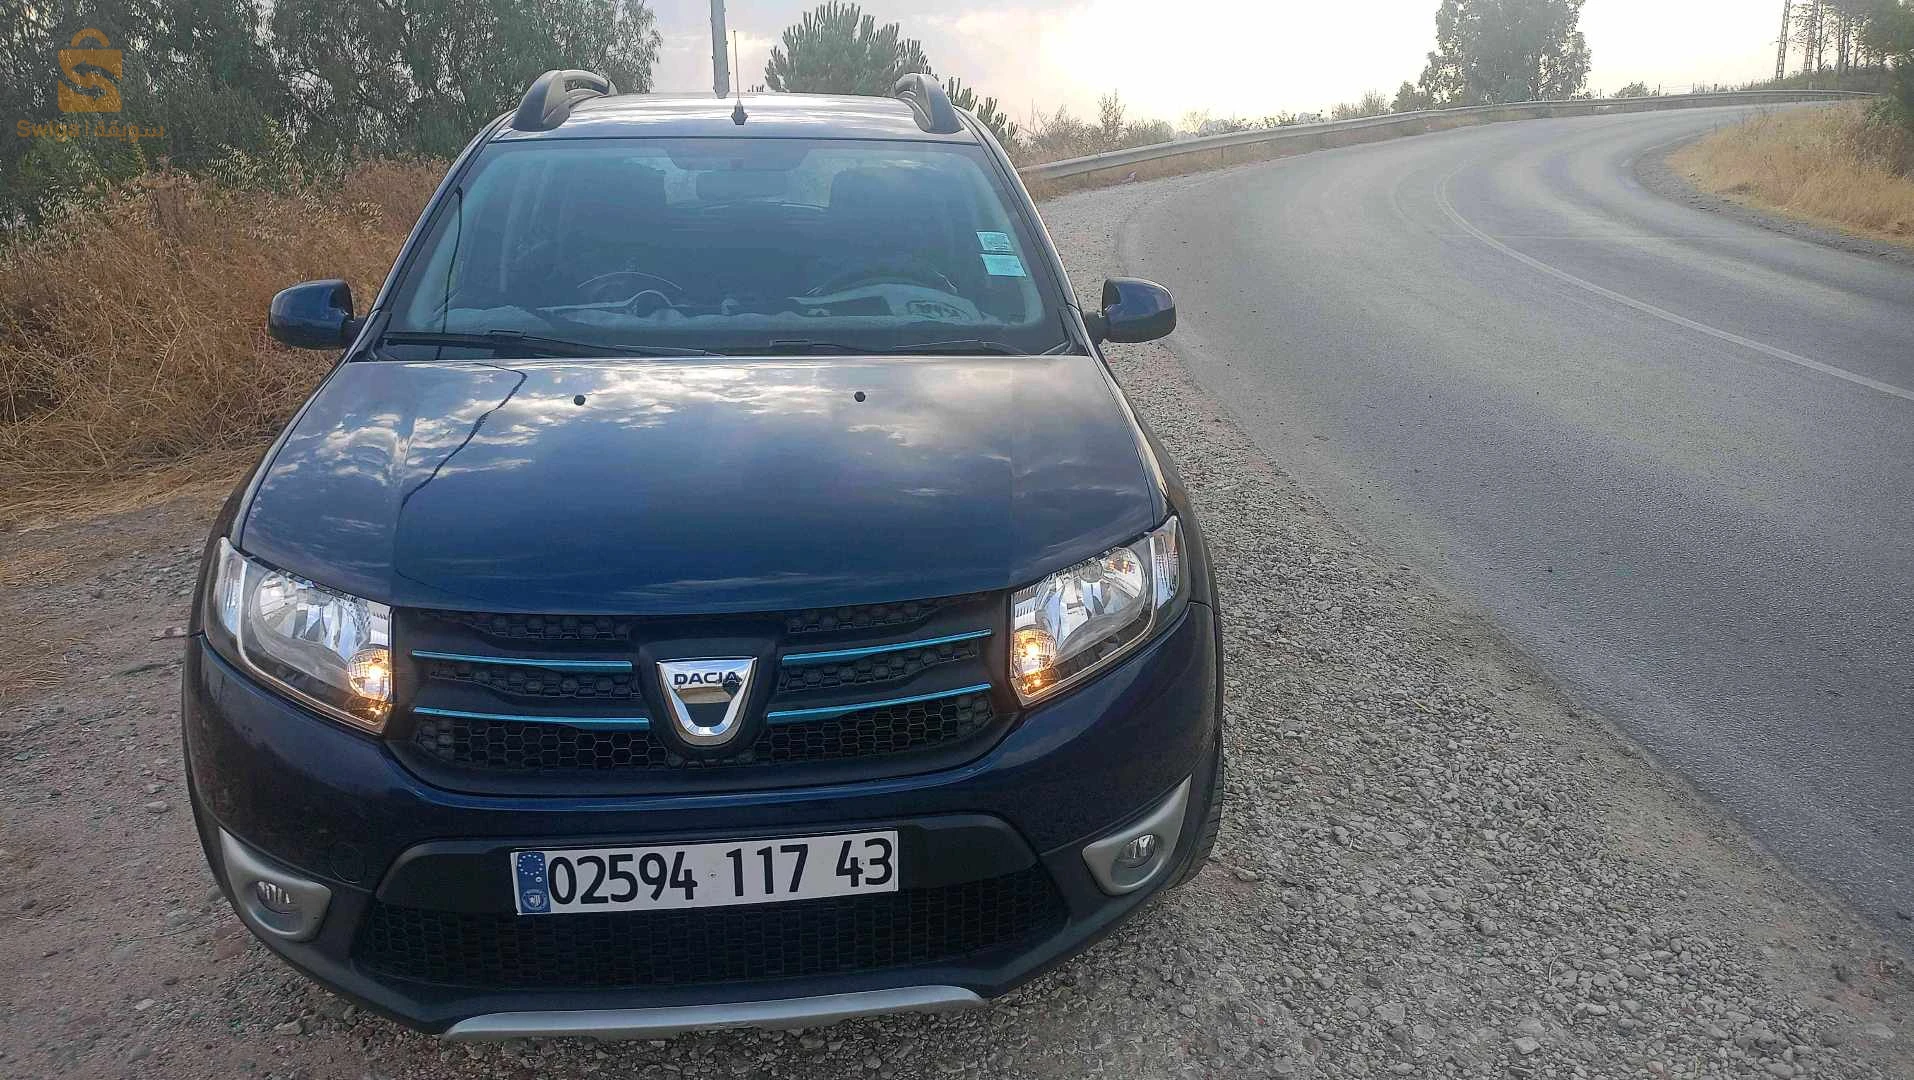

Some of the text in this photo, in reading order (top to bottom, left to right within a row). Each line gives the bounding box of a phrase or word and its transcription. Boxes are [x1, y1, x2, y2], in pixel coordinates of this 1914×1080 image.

[674, 671, 739, 685] DACIA
[547, 838, 893, 905] 02594 117 43
